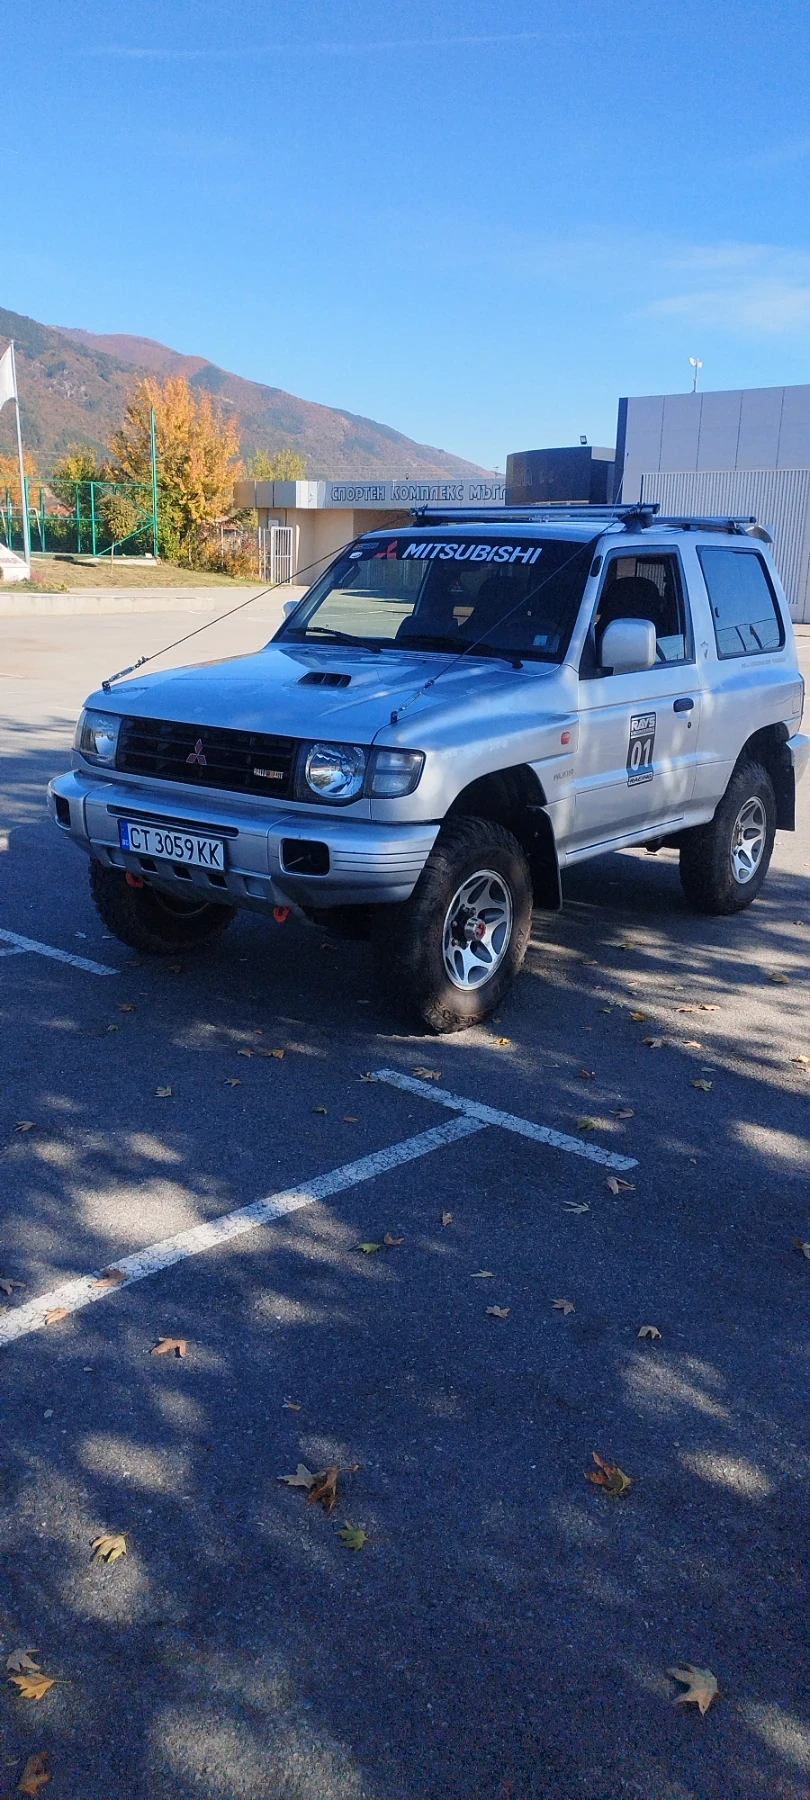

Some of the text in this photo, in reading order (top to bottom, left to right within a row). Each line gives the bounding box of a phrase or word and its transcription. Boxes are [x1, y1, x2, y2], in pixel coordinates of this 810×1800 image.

[331, 486, 386, 501] СПОРТЕН
[391, 485, 464, 501] КОМПЛЕКС
[402, 543, 542, 564] MITSUBISHI
[631, 717, 655, 731] RAYS
[631, 738, 651, 771] 01
[130, 827, 220, 866] CT 3059 KK
